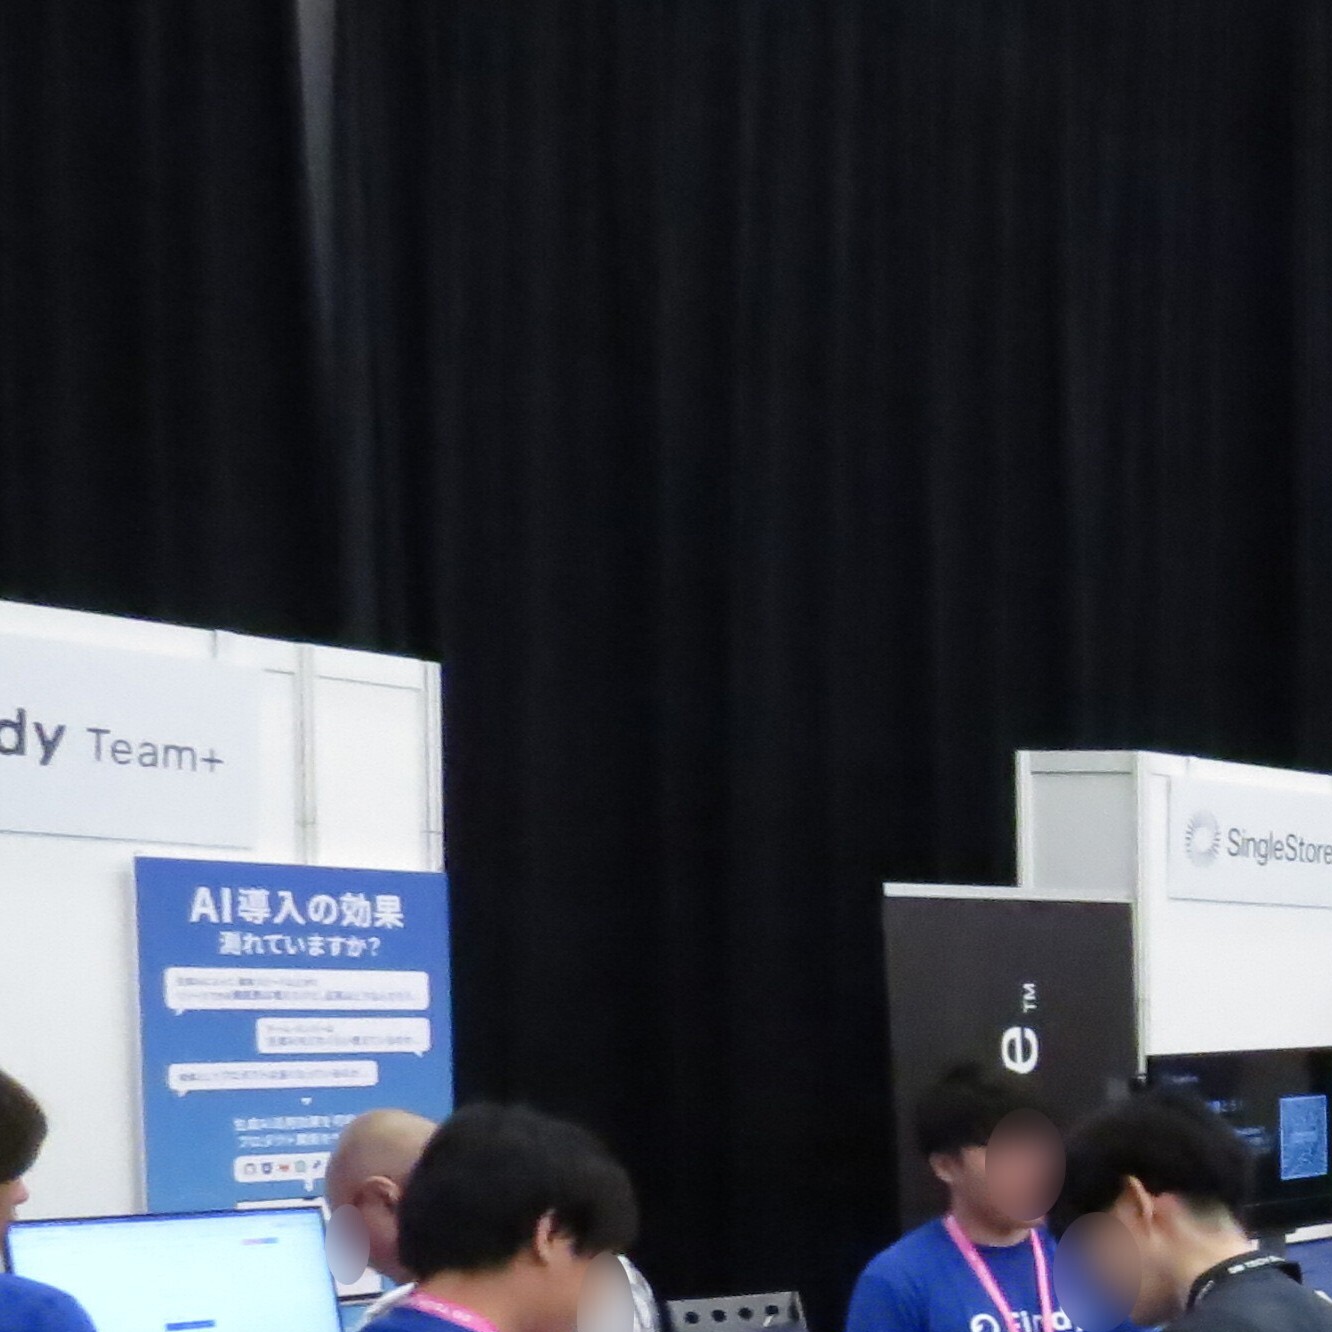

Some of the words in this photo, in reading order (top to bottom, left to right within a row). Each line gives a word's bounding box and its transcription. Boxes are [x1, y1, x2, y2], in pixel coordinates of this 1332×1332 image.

[86, 727, 225, 772] Team+
[189, 886, 405, 929] AI導入の効果
